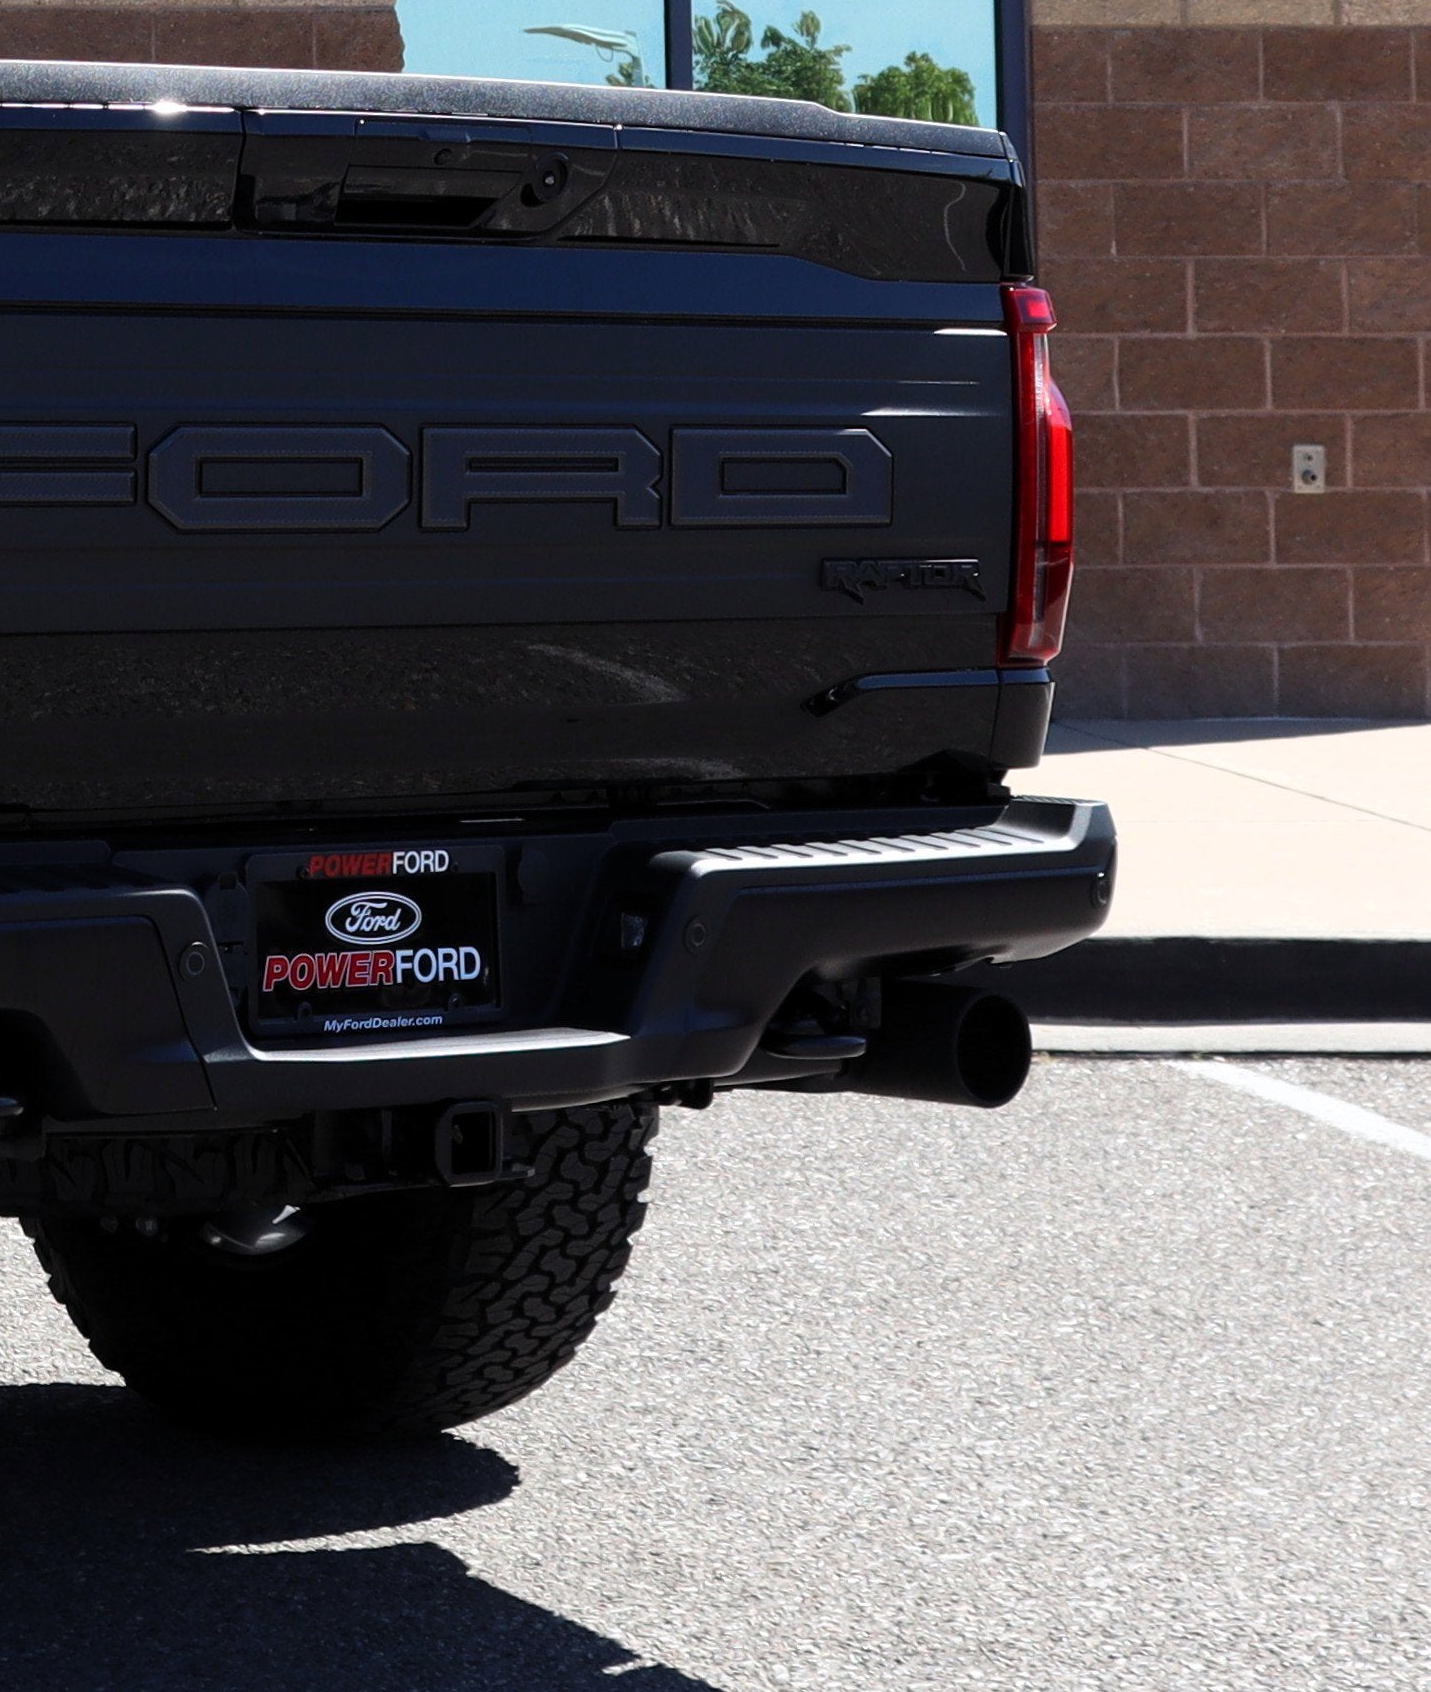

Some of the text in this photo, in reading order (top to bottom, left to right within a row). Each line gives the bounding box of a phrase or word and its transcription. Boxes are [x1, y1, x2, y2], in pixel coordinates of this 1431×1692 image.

[820, 557, 986, 605] RAPTOR
[345, 901, 401, 932] Ford
[323, 1015, 443, 1033] MyFordDealer.com
